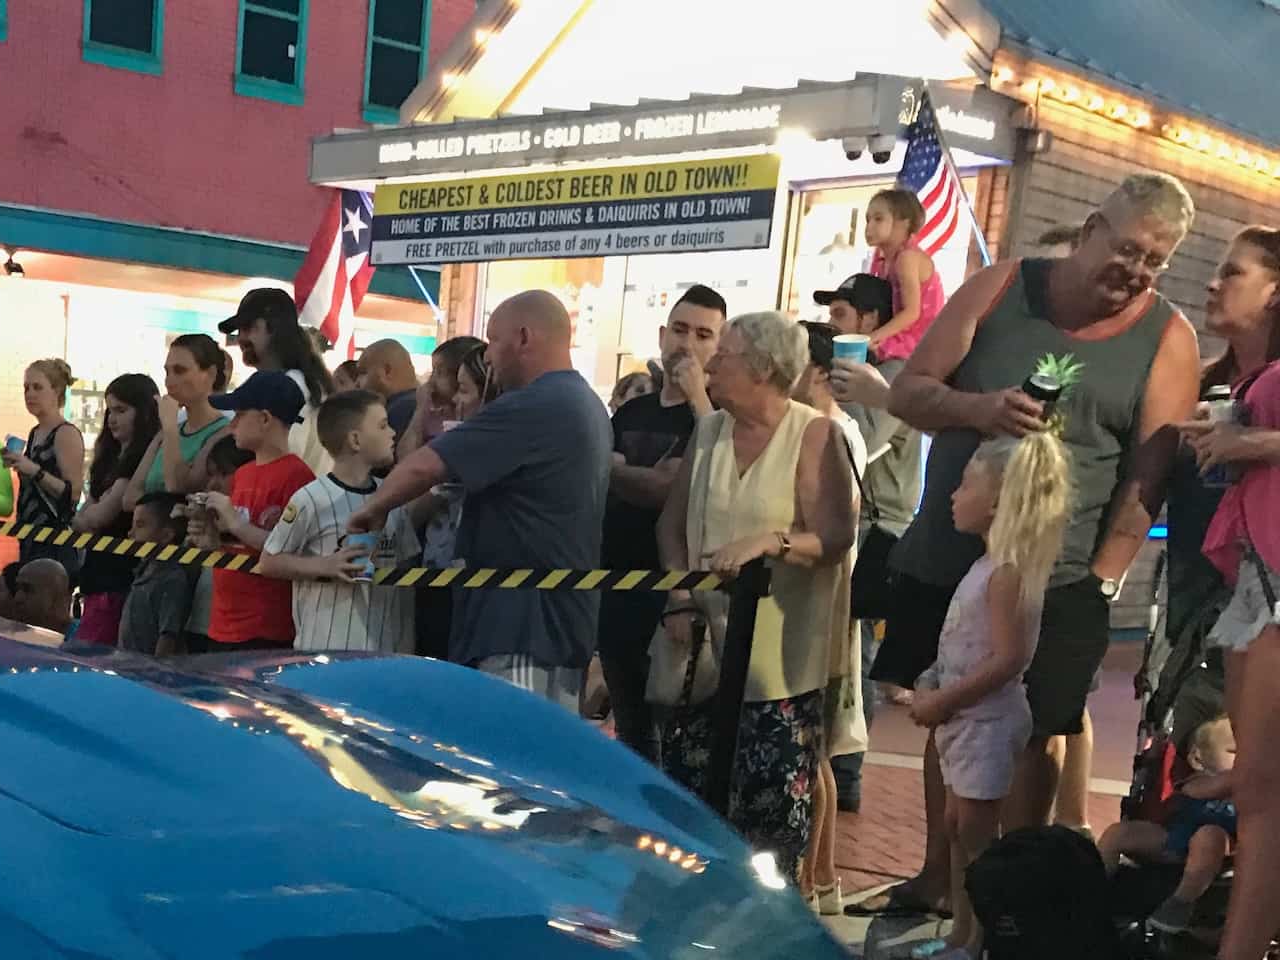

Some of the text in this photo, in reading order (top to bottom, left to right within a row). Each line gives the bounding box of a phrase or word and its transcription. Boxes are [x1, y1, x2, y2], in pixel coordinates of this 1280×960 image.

[543, 125, 580, 149] COLD
[399, 163, 749, 210] CHEAPEST & COLDEST BEER IN OLD TOWN!!
[390, 197, 751, 235] HOME OF THE BEST FROZEN DRINKS & DAIQUIRIS IN OLD TOWN!
[405, 229, 725, 258] FREE PRETZEL with purchase of any 4 beers or daiquiris
